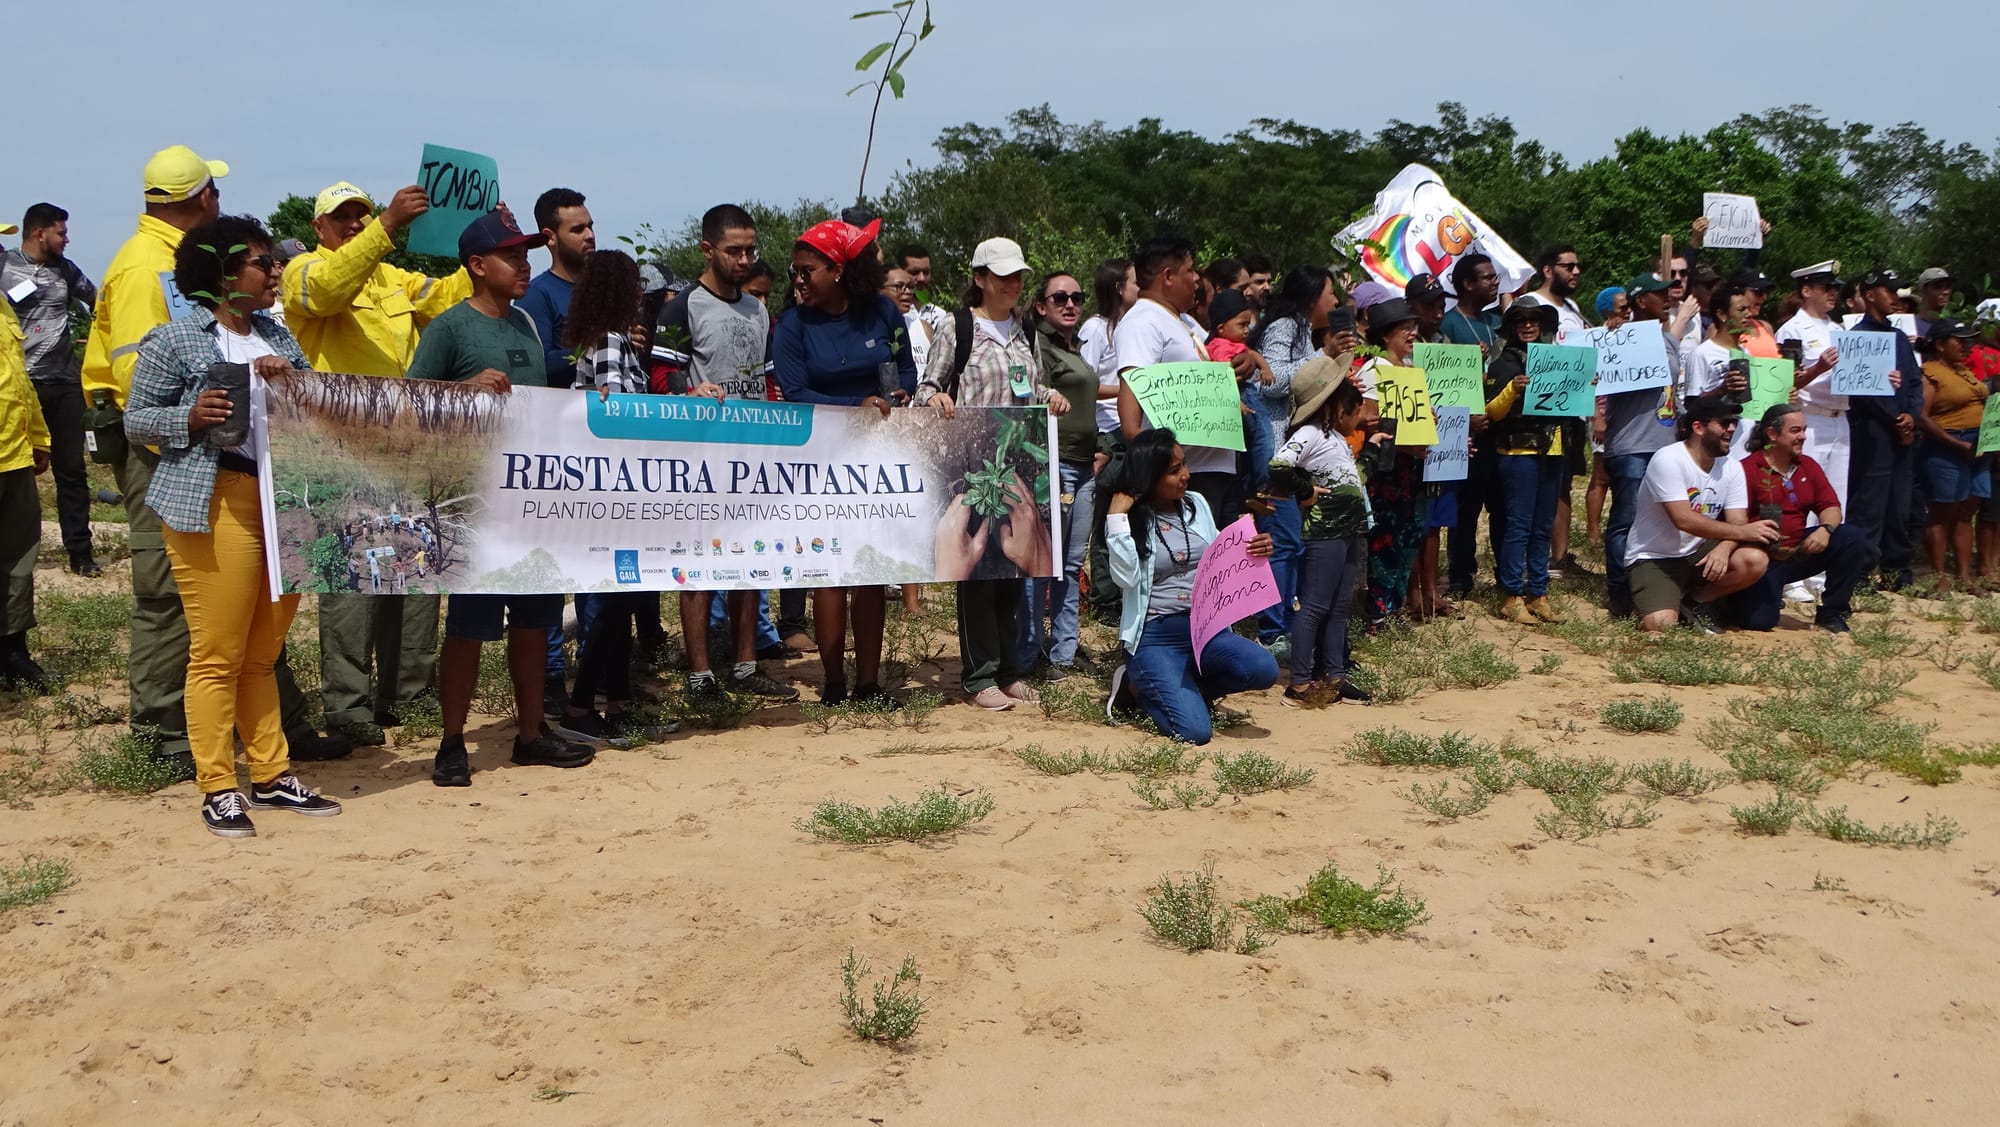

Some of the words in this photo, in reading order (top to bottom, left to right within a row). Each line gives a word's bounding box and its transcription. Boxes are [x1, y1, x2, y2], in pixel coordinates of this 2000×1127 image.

[1585, 328, 1637, 349] REDE
[1838, 336, 1890, 361] MARINHA
[1602, 350, 1622, 365] de
[1600, 365, 1668, 384] MUNIDADES
[1834, 368, 1885, 393] BRASIL
[604, 400, 620, 417] 12
[659, 403, 690, 421] DIA
[694, 404, 717, 422] DO
[720, 405, 803, 426] PANTANAL
[1379, 380, 1427, 423] FASE
[499, 453, 717, 494] RESTAURA
[726, 460, 924, 495] PANTANAL
[522, 500, 606, 520] PLANTIO
[611, 502, 637, 520] DE
[641, 498, 720, 521] ESPÉCIES
[724, 503, 791, 521] NATIVAS
[795, 504, 821, 521] DO
[825, 502, 916, 521] PANTANAL
[620, 571, 637, 581] GAIA
[688, 571, 702, 579] GEF
